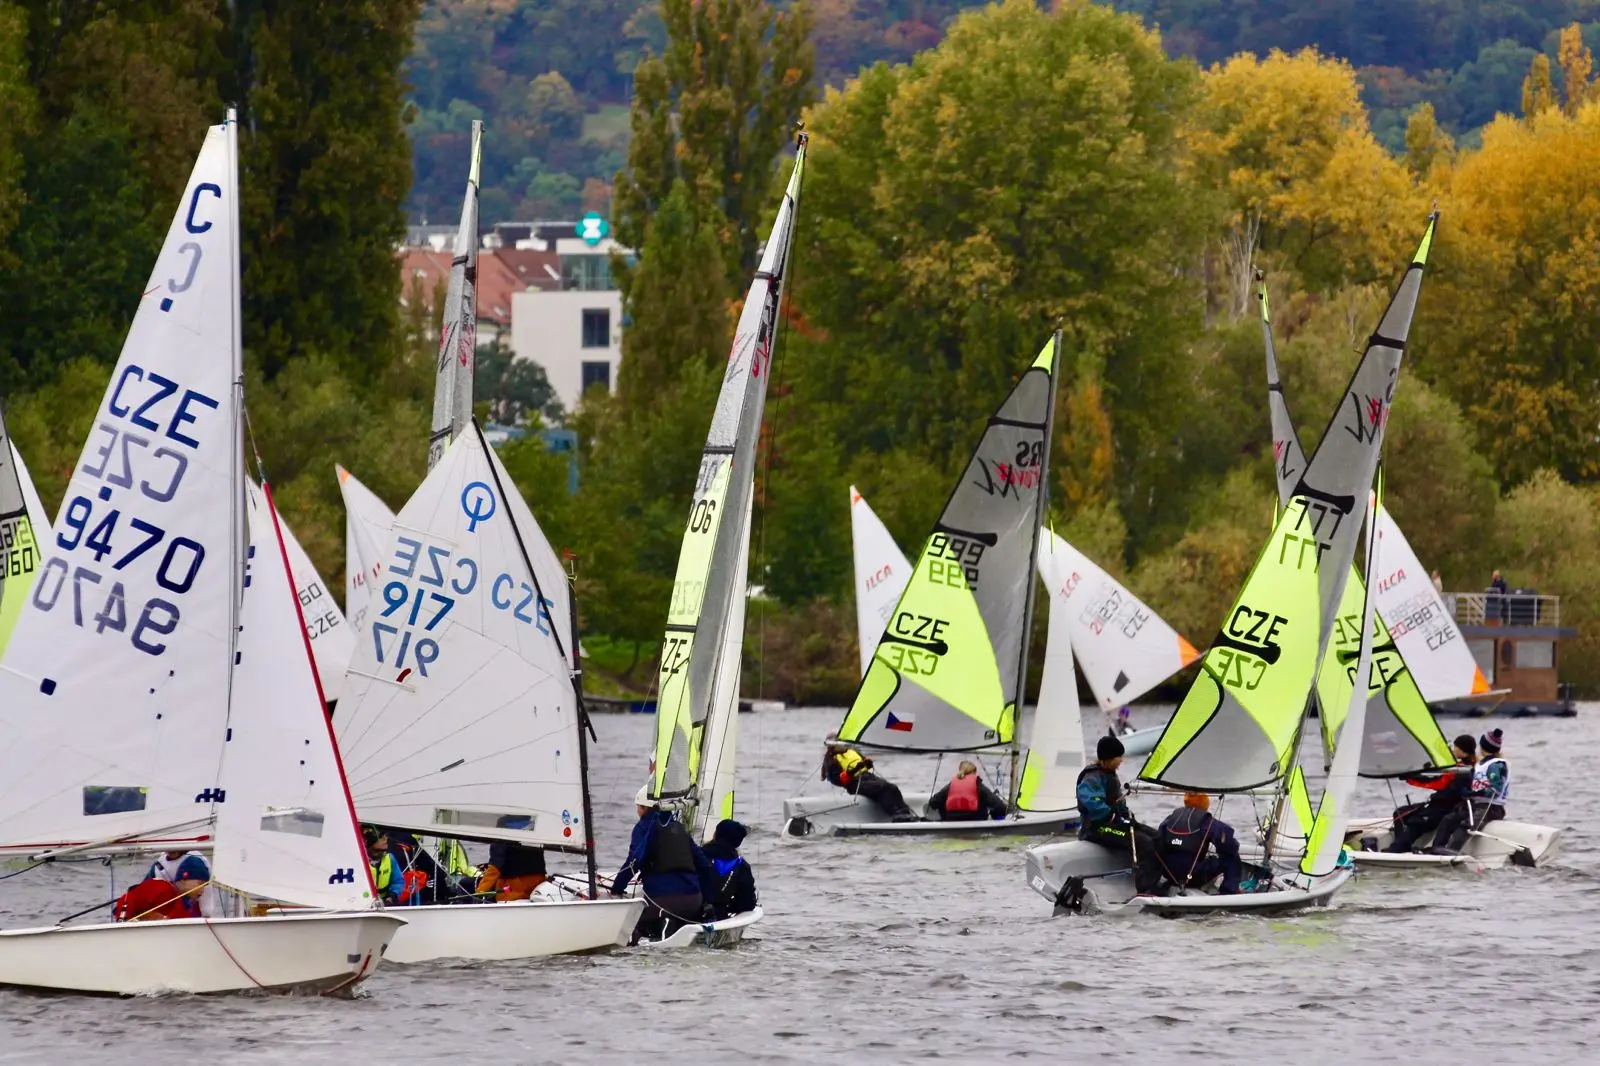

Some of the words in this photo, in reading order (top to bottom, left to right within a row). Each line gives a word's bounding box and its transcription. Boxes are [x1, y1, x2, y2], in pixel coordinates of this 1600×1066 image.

[108, 364, 219, 449] CZE
[686, 499, 716, 534] 06
[1295, 498, 1344, 540] 777
[56, 496, 206, 594] 9470
[927, 535, 985, 566] 999
[865, 564, 892, 592] ILCA
[1378, 568, 1407, 595] ILCA
[380, 581, 455, 631] 917
[492, 573, 554, 637] CZE
[1389, 600, 1441, 641] 202887
[306, 610, 340, 640] CZE
[895, 612, 950, 642] CZE
[1123, 608, 1149, 639] CZE
[1229, 605, 1288, 647] CZE
[1426, 625, 1456, 651] CZE
